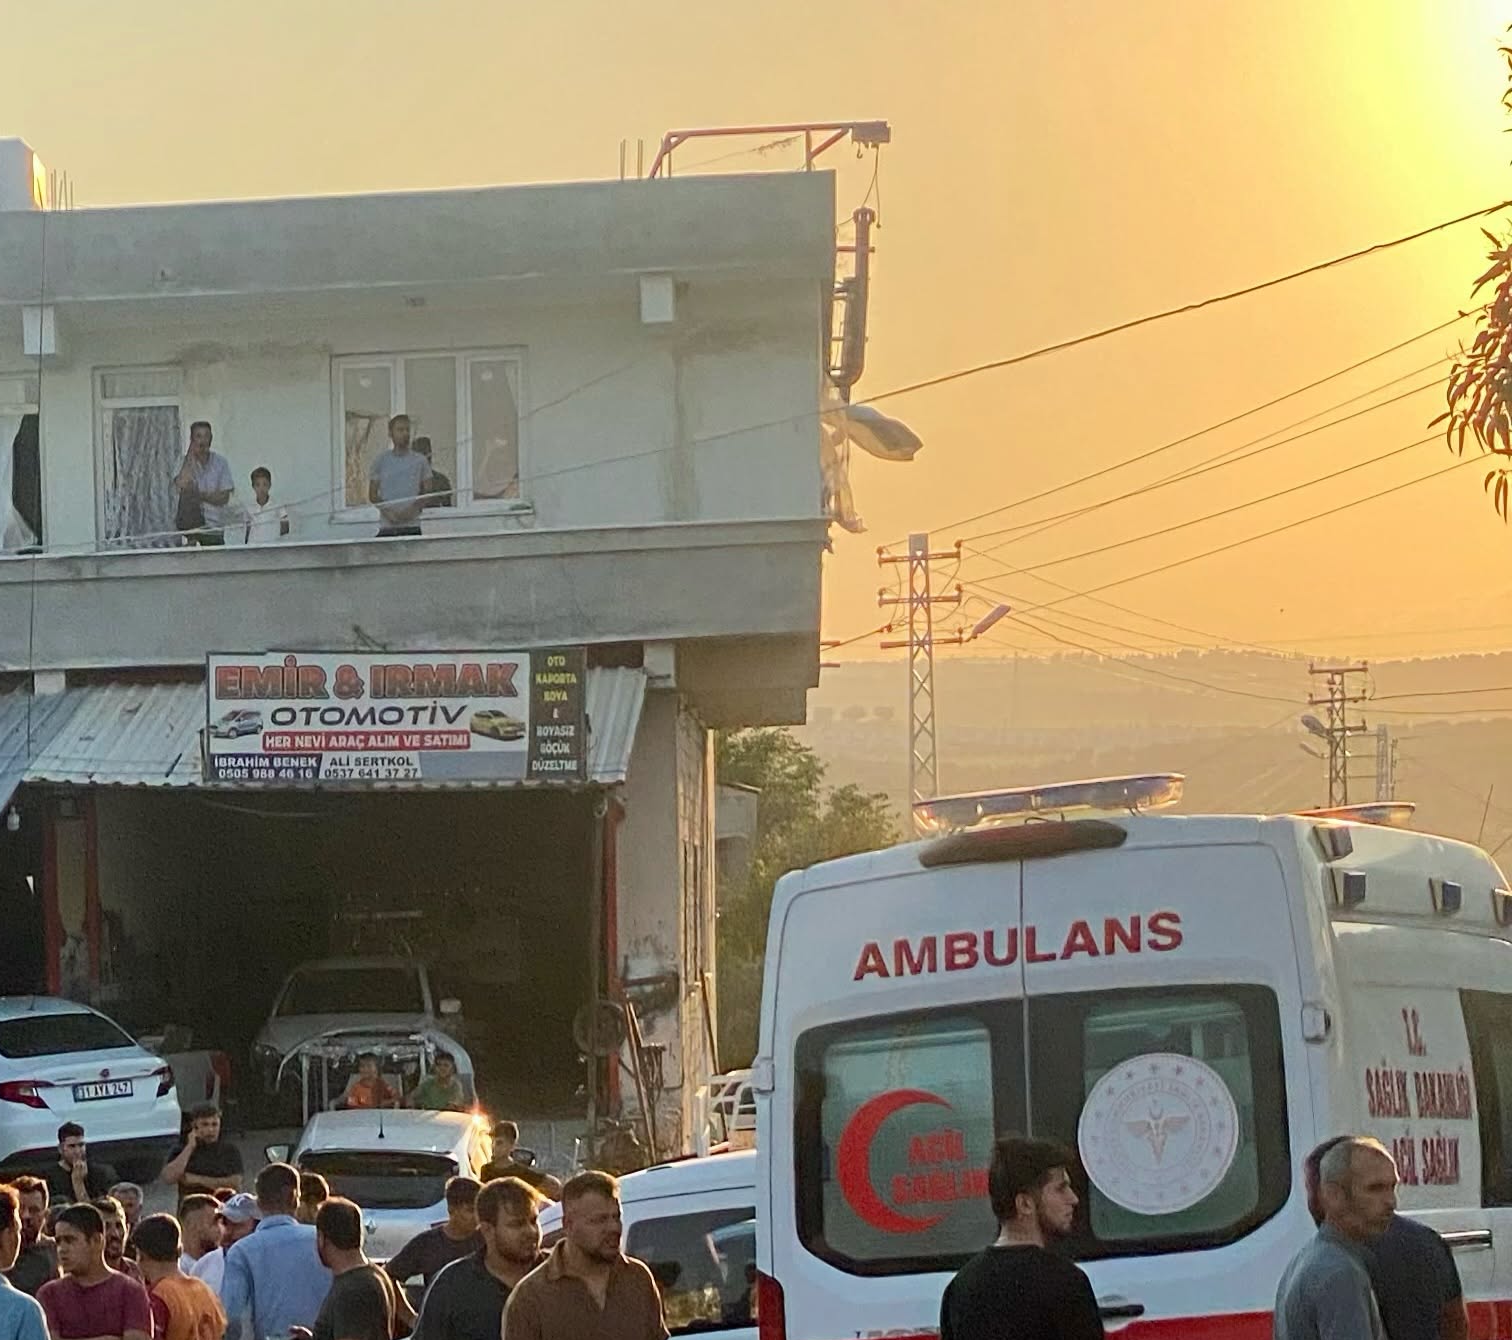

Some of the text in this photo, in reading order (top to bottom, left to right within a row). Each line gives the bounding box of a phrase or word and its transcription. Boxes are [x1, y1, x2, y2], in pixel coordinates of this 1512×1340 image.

[547, 655, 566, 667] OTO
[215, 655, 518, 699] EMİR & IRMAK
[543, 690, 568, 701] BOYA
[271, 701, 468, 726] OTOMOTİV
[266, 733, 468, 750] HER NEVİ ARAÇ ALIM VE SATIMI
[215, 755, 318, 767] İBRAHİM BENEK
[330, 755, 414, 767] ALİ SERTKOL
[219, 767, 313, 778] 0505 988 46 16
[325, 767, 418, 778] 0537 641 37 27
[853, 911, 1184, 981] AMBULANS
[1366, 1059, 1411, 1118] SAĞLIK
[1422, 1129, 1460, 1186] SAĞLIK
